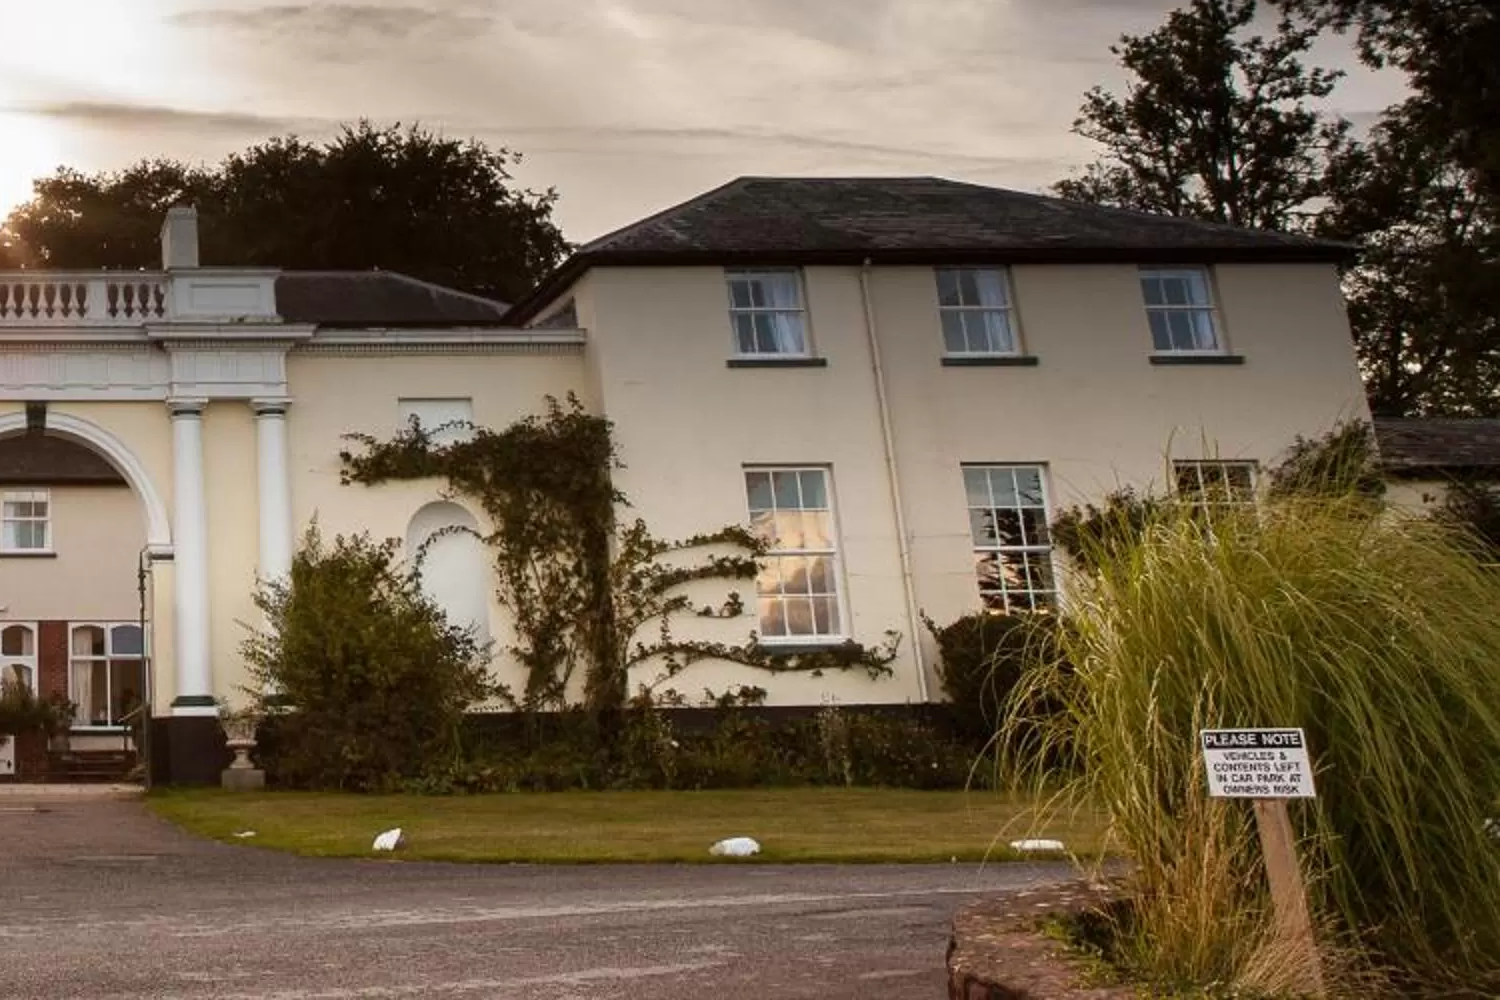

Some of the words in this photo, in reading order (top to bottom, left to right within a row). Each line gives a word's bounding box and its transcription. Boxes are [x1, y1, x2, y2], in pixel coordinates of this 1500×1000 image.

[1205, 734, 1256, 746] PLEASE
[1261, 733, 1300, 745] NOTE
[1223, 751, 1275, 761] VEHICLES
[1279, 751, 1287, 760] &
[1213, 762, 1270, 772] CONTENTS
[1274, 762, 1300, 772] LEFT
[1216, 774, 1228, 783] IN
[1231, 773, 1253, 783] CAR
[1257, 773, 1284, 782] PARK
[1288, 773, 1302, 783] AT
[1273, 785, 1299, 794] RISK
